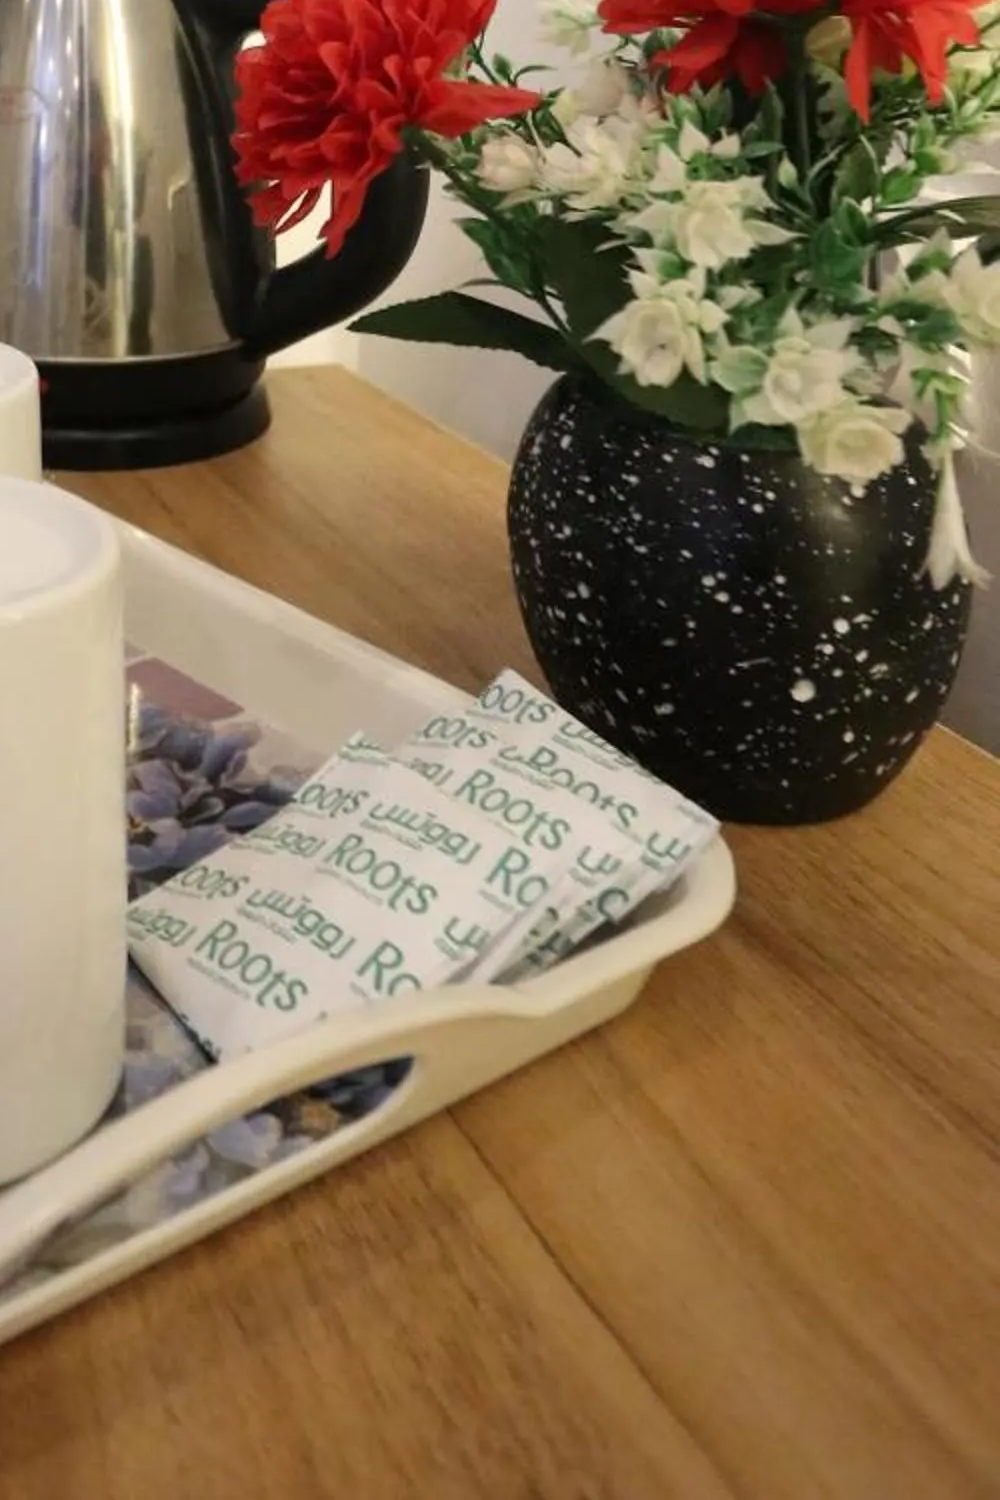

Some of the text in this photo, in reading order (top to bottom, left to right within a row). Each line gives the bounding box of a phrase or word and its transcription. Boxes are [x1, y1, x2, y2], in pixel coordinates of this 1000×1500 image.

[478, 684, 557, 724] oots
[421, 716, 497, 749] oots
[300, 782, 370, 819] oots
[454, 767, 572, 851] Roots
[180, 865, 251, 900] oots
[323, 831, 439, 916] Roots
[194, 919, 310, 1014] Roots
